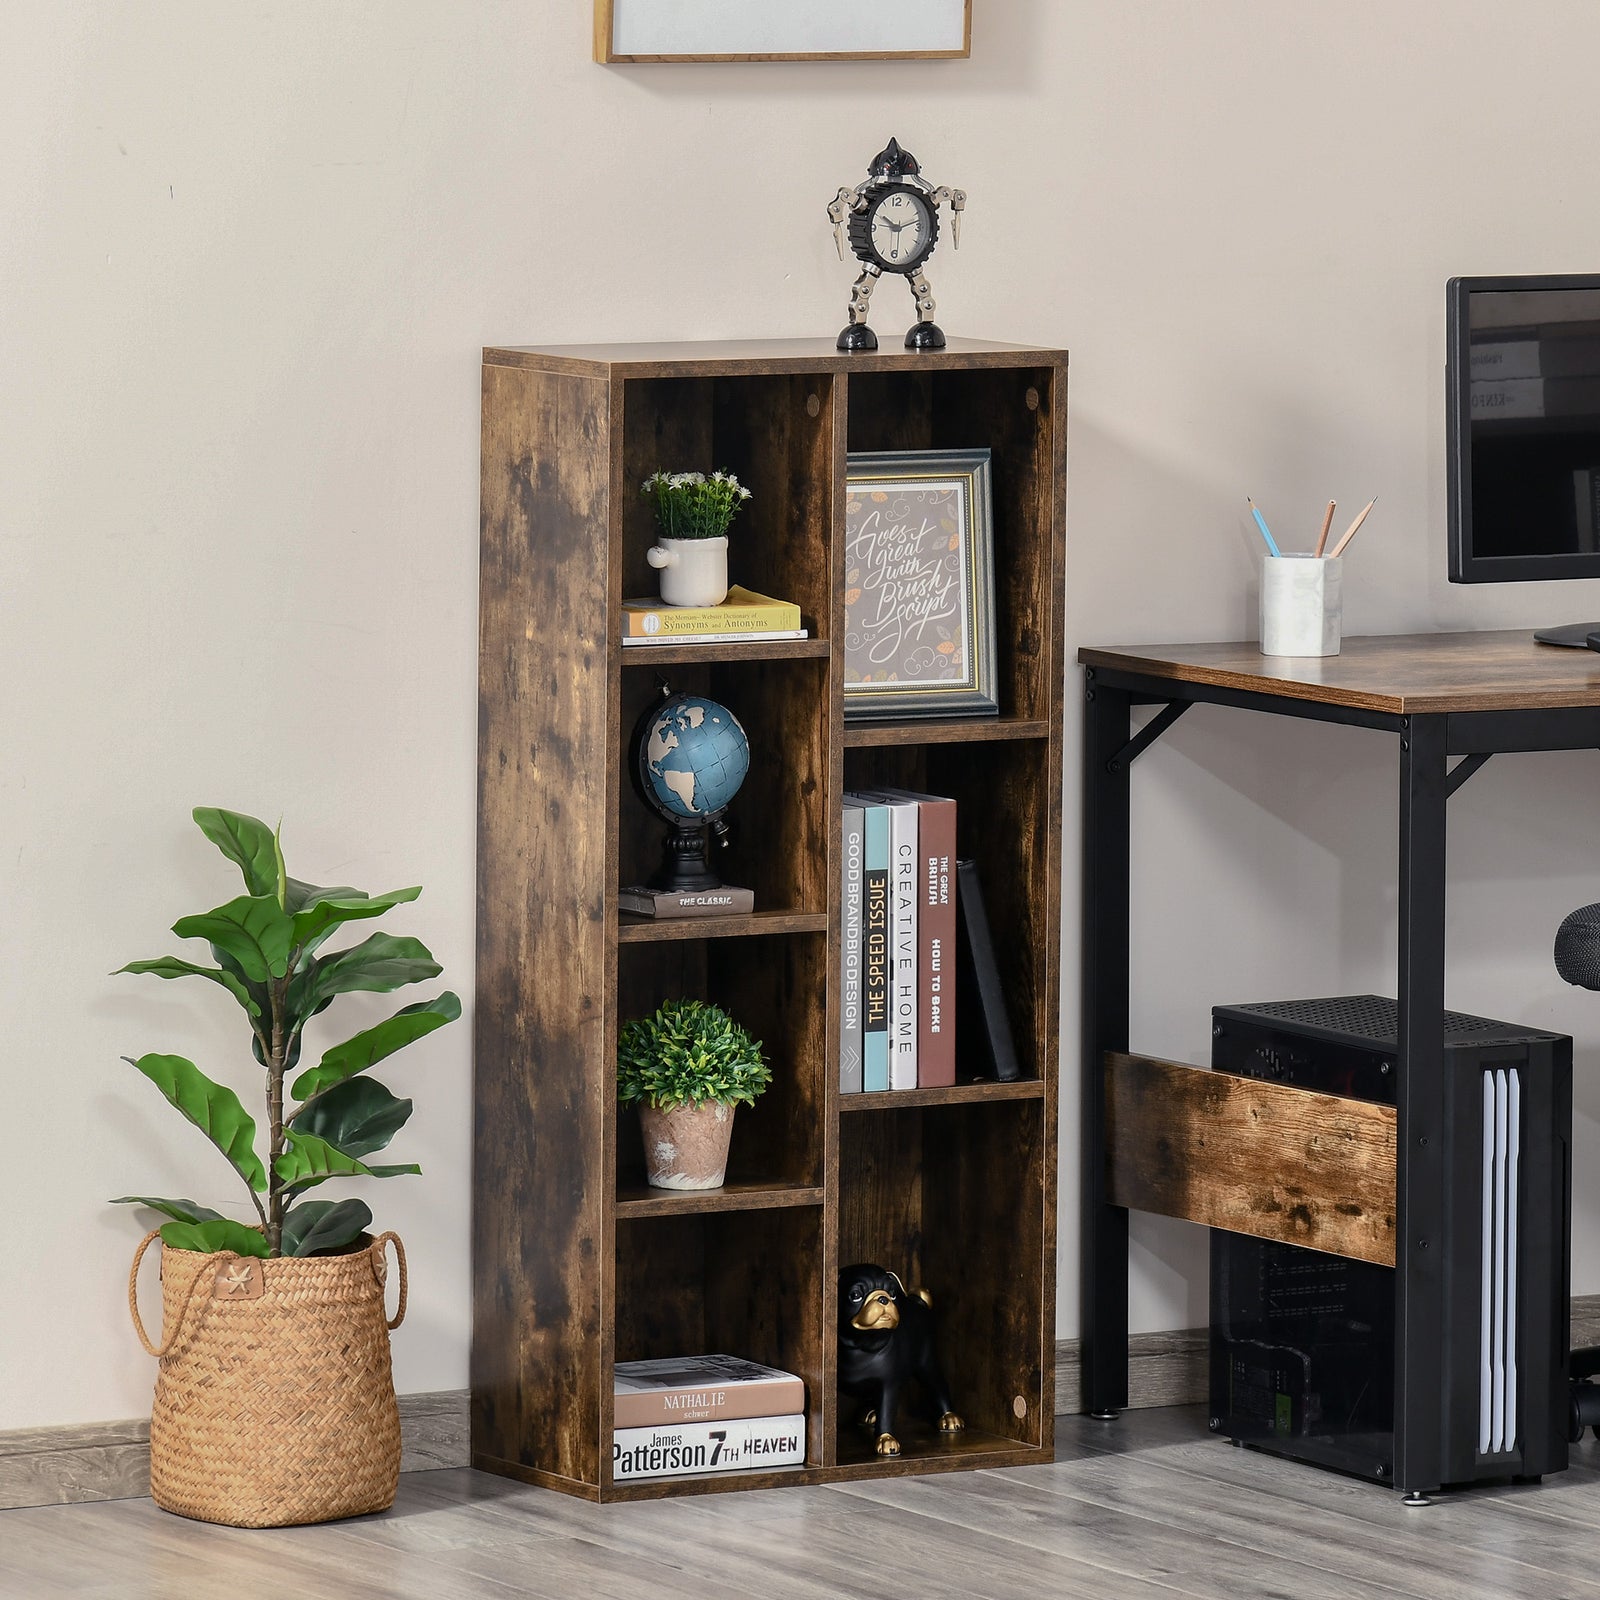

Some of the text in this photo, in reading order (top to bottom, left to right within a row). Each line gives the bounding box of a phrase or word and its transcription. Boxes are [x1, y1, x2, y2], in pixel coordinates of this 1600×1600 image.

[892, 197, 902, 207] 12
[915, 223, 922, 232] 3
[891, 249, 898, 258] 6
[846, 510, 917, 569] Goes
[863, 518, 937, 590] great
[886, 557, 936, 581] with
[862, 559, 942, 628] Brush
[664, 620, 709, 631] Synonyms
[724, 619, 768, 629] Antonyms
[869, 576, 959, 663] Script
[679, 896, 733, 907] THE CLASSIC
[928, 857, 938, 905] BRITISH
[940, 856, 948, 905] THE GREAT
[845, 832, 860, 1030] GOOD BRANDBIG DESIGN
[868, 878, 885, 1024] THE SPEED ISSUE
[898, 844, 912, 1054] CREATIVE HOME
[931, 939, 941, 1033] HOW TO BAKE
[663, 1392, 725, 1410] NATHALIE
[683, 1409, 710, 1419] schwer
[613, 1443, 706, 1473] Patterson
[743, 1436, 798, 1455] HEAVEN
[649, 1433, 682, 1448] James
